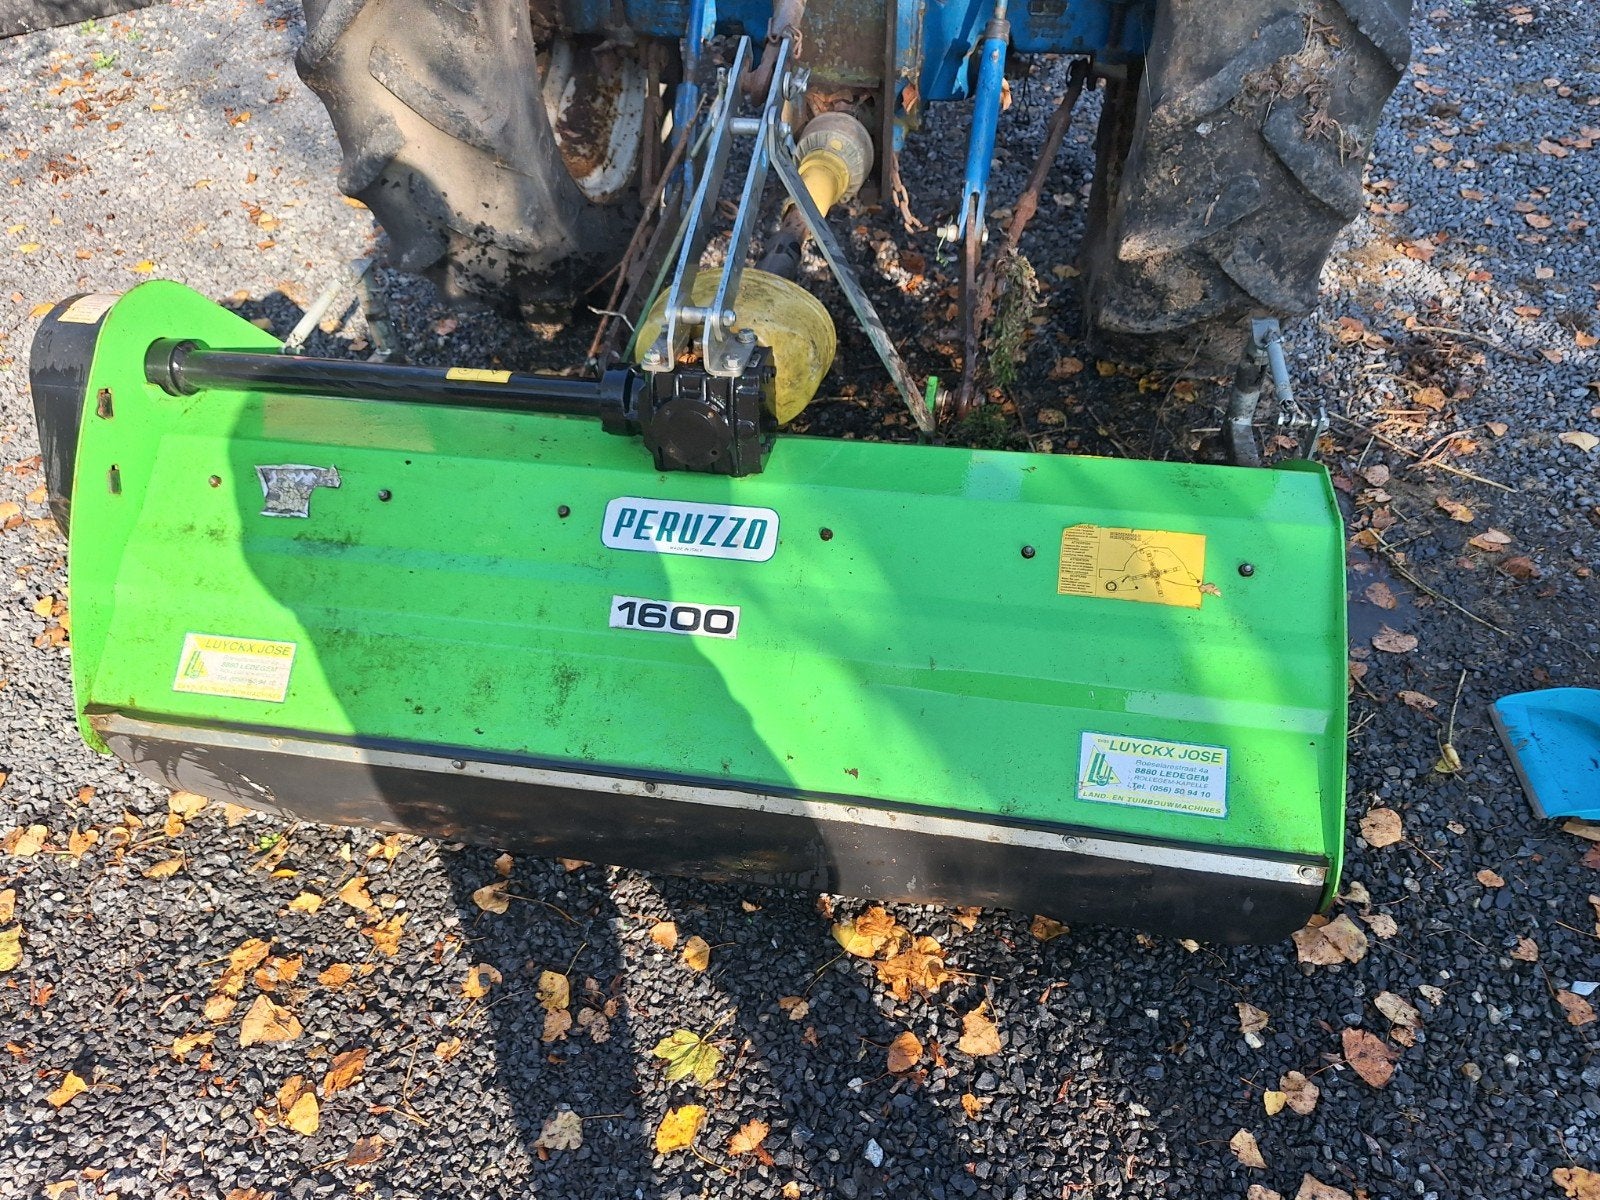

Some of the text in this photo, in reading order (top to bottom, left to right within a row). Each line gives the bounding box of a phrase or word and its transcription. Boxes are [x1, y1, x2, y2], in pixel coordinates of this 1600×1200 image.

[612, 507, 769, 550] PERUZZO
[617, 601, 735, 635] 1600
[205, 639, 292, 656] LUYCKX JOSE
[1109, 739, 1223, 764] LUYCKX JOSE
[1134, 767, 1209, 782] 8880 LEDEGEM
[1135, 759, 1198, 773] Roeselarestraat
[1132, 782, 1147, 790] Tel.
[1149, 784, 1172, 794] (056)
[1174, 787, 1185, 795] 50
[1133, 775, 1210, 788] ROLLEGEM-KAPELLE
[1127, 796, 1222, 815] TUINBOUWMACHINES
